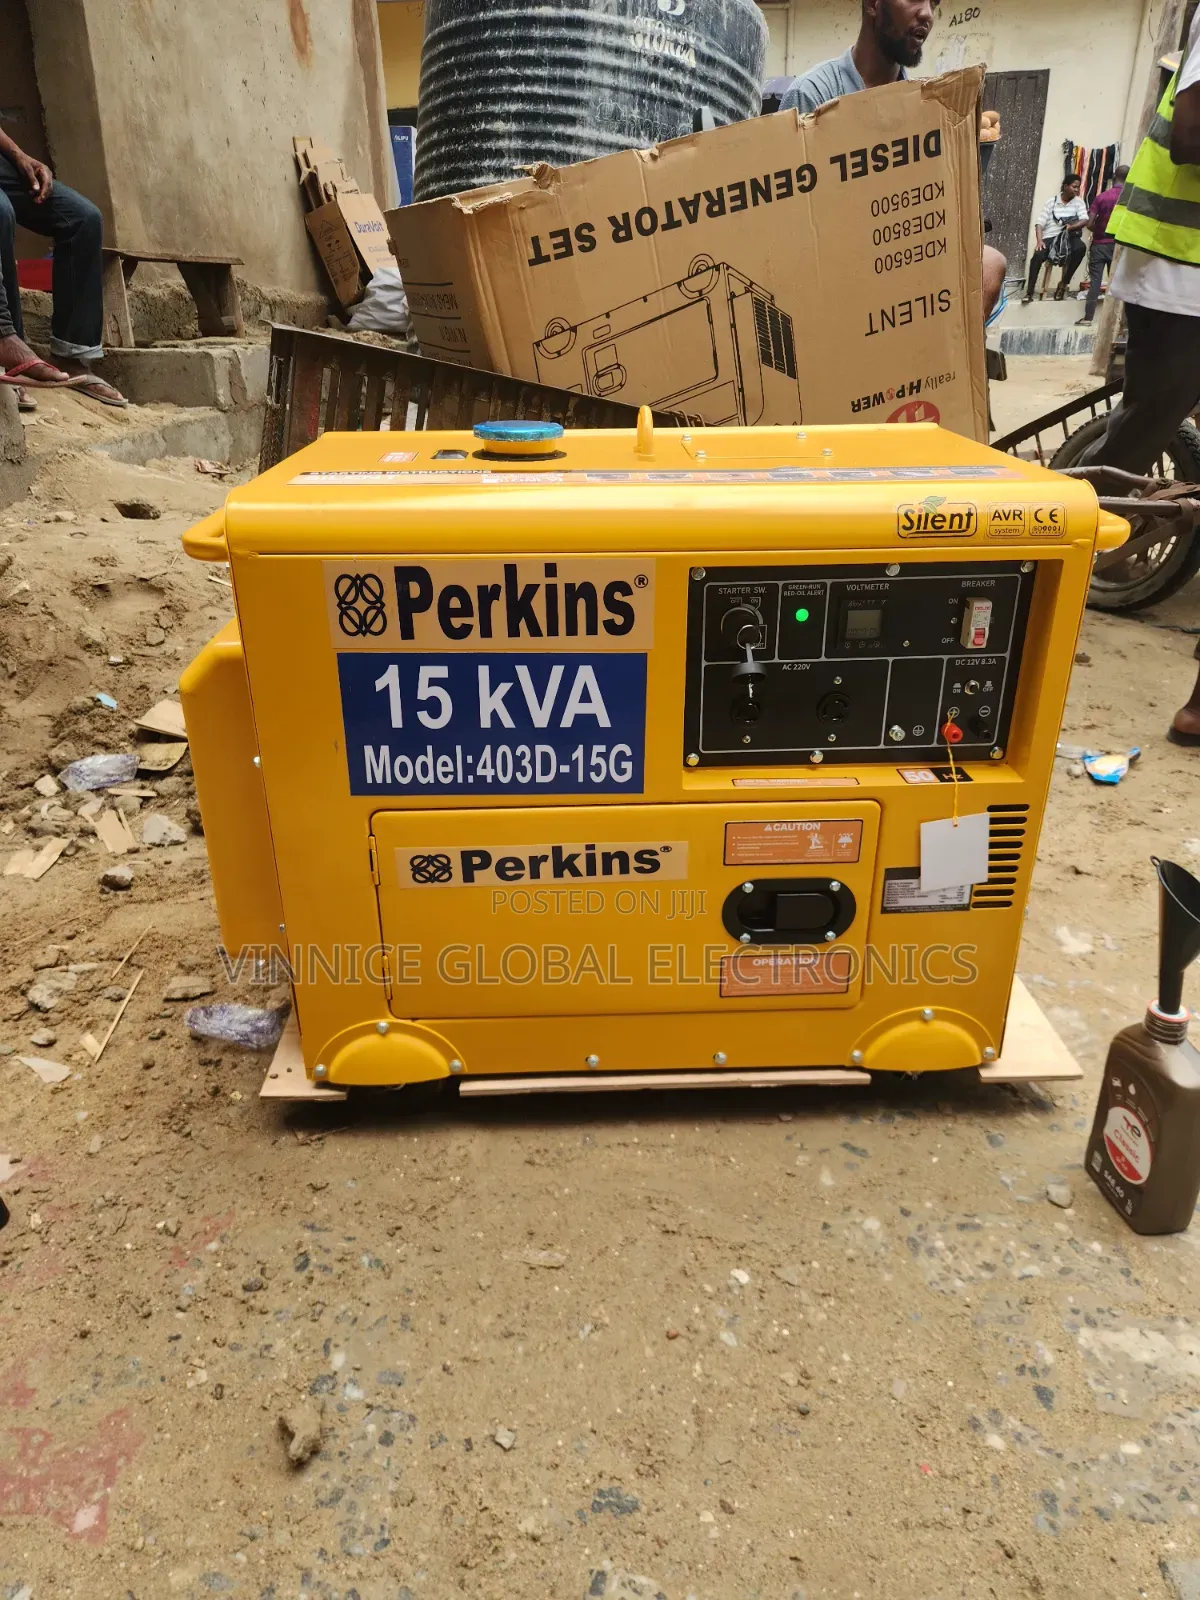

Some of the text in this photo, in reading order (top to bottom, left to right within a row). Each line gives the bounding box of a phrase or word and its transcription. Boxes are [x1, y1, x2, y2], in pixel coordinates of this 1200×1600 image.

[528, 128, 942, 267] DIESEL GENERATOR SET
[871, 180, 946, 217] KDE9500
[872, 208, 947, 246] KDE8500
[874, 236, 948, 274] KDE6500
[864, 287, 951, 336] SILENT
[924, 371, 956, 390] really
[901, 507, 973, 531] Silent
[991, 508, 1022, 522] AVR
[993, 527, 1020, 536] system
[718, 586, 750, 595] STARTER
[846, 583, 890, 591] VOLTMETER
[961, 580, 996, 588] BREAKER
[374, 664, 612, 730] 15 kVA
[363, 743, 633, 785] Model:403D-15G
[903, 770, 934, 783] 50
[773, 822, 820, 832] CAUTION
